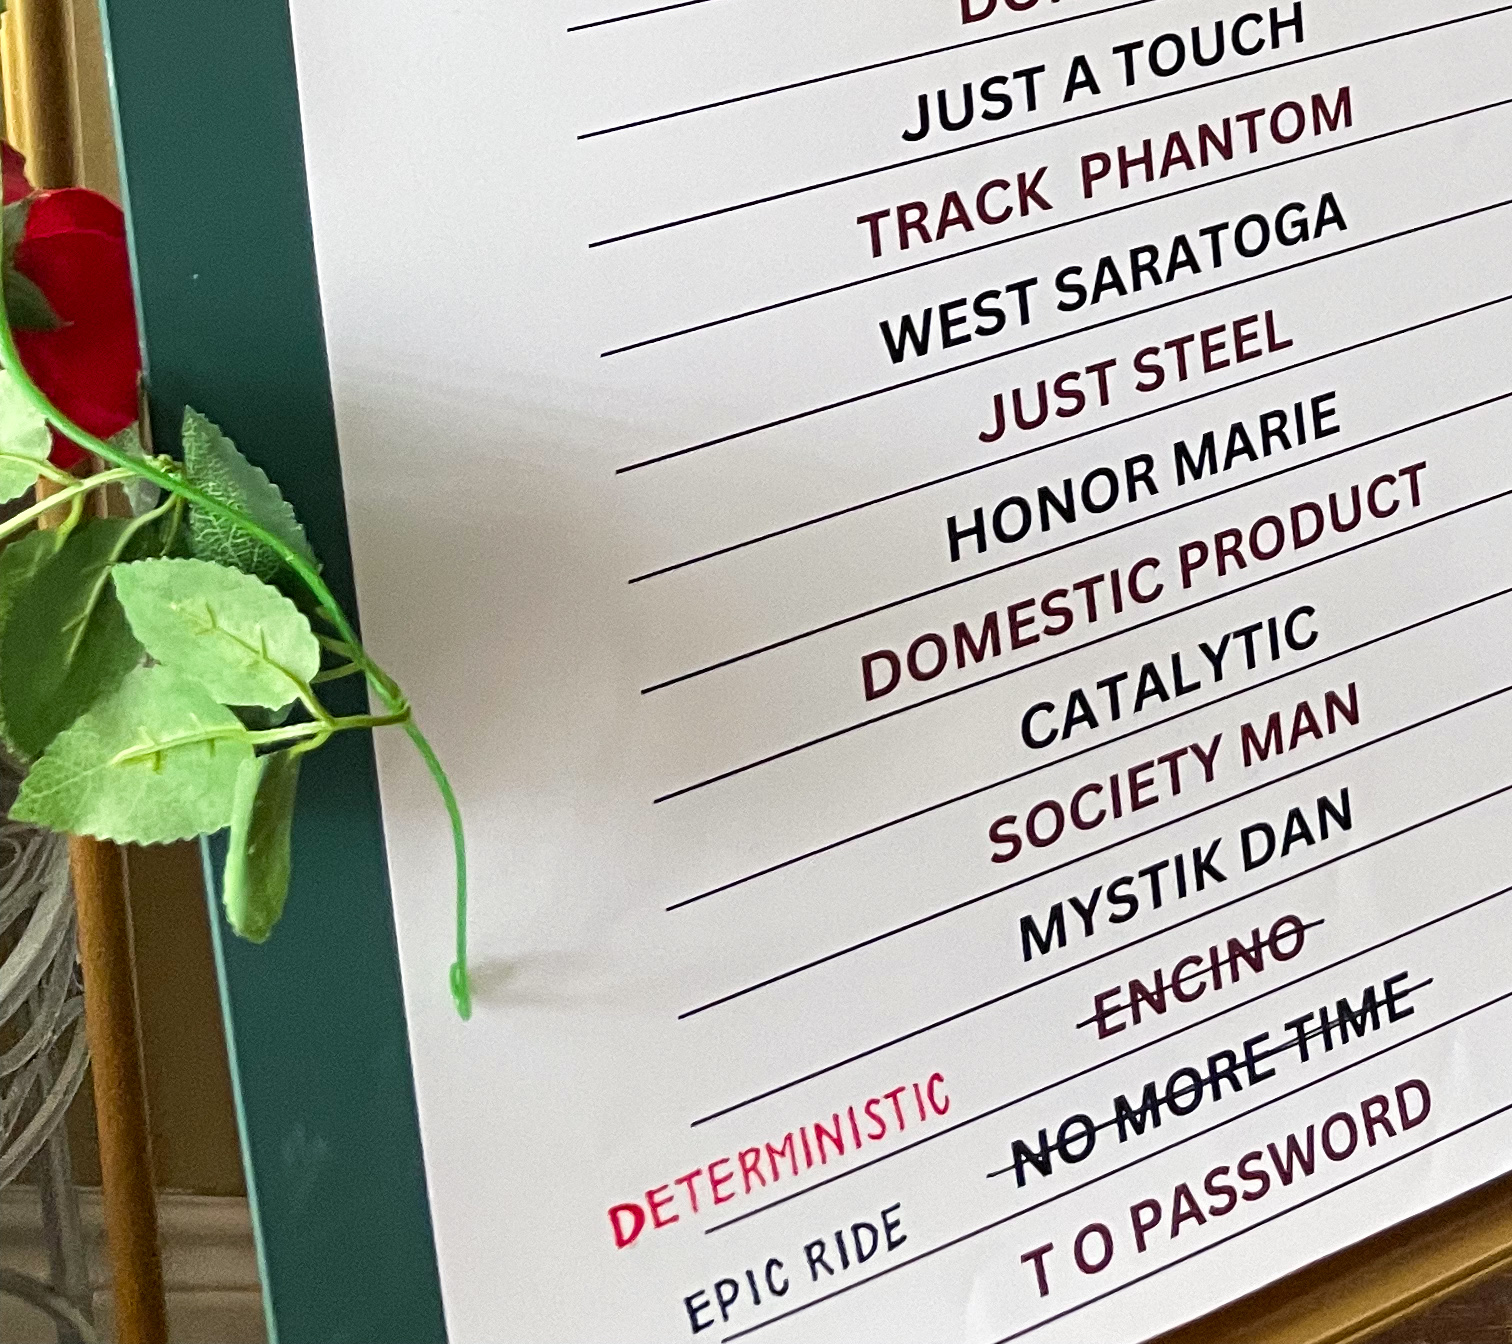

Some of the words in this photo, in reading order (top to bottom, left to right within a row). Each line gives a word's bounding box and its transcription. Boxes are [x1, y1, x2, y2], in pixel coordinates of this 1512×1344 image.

[901, 65, 1046, 143] JUST
[1062, 54, 1102, 103] A
[1112, 0, 1306, 87] TOUCH
[856, 166, 1053, 258] TRACK
[1079, 86, 1355, 199] PHANTOM
[879, 277, 1040, 365] WEST
[1054, 191, 1348, 313] SARATOGA
[978, 359, 1117, 444] JUST
[1134, 309, 1294, 392] STEEL
[946, 453, 1159, 564] HONOR
[1173, 390, 1341, 486] MARIE
[860, 556, 1165, 703] DOMESTIC
[1179, 461, 1428, 589] PRODUCT
[1020, 605, 1319, 750] CATALYTIC
[988, 733, 1223, 864] SOCIETY
[1240, 682, 1362, 768] MAN
[1020, 837, 1229, 963] MYSTIK
[1241, 787, 1353, 872] DAN
[1095, 913, 1306, 1041] ENCINO
[607, 1071, 951, 1249] DETERMINISTIC
[1011, 1113, 1100, 1189] NO
[1112, 1035, 1278, 1145] MORE
[1284, 970, 1415, 1064] TIME
[1129, 1077, 1433, 1253] PASSWORD
[684, 1258, 791, 1336] EPIC
[804, 1202, 909, 1282] RIDE
